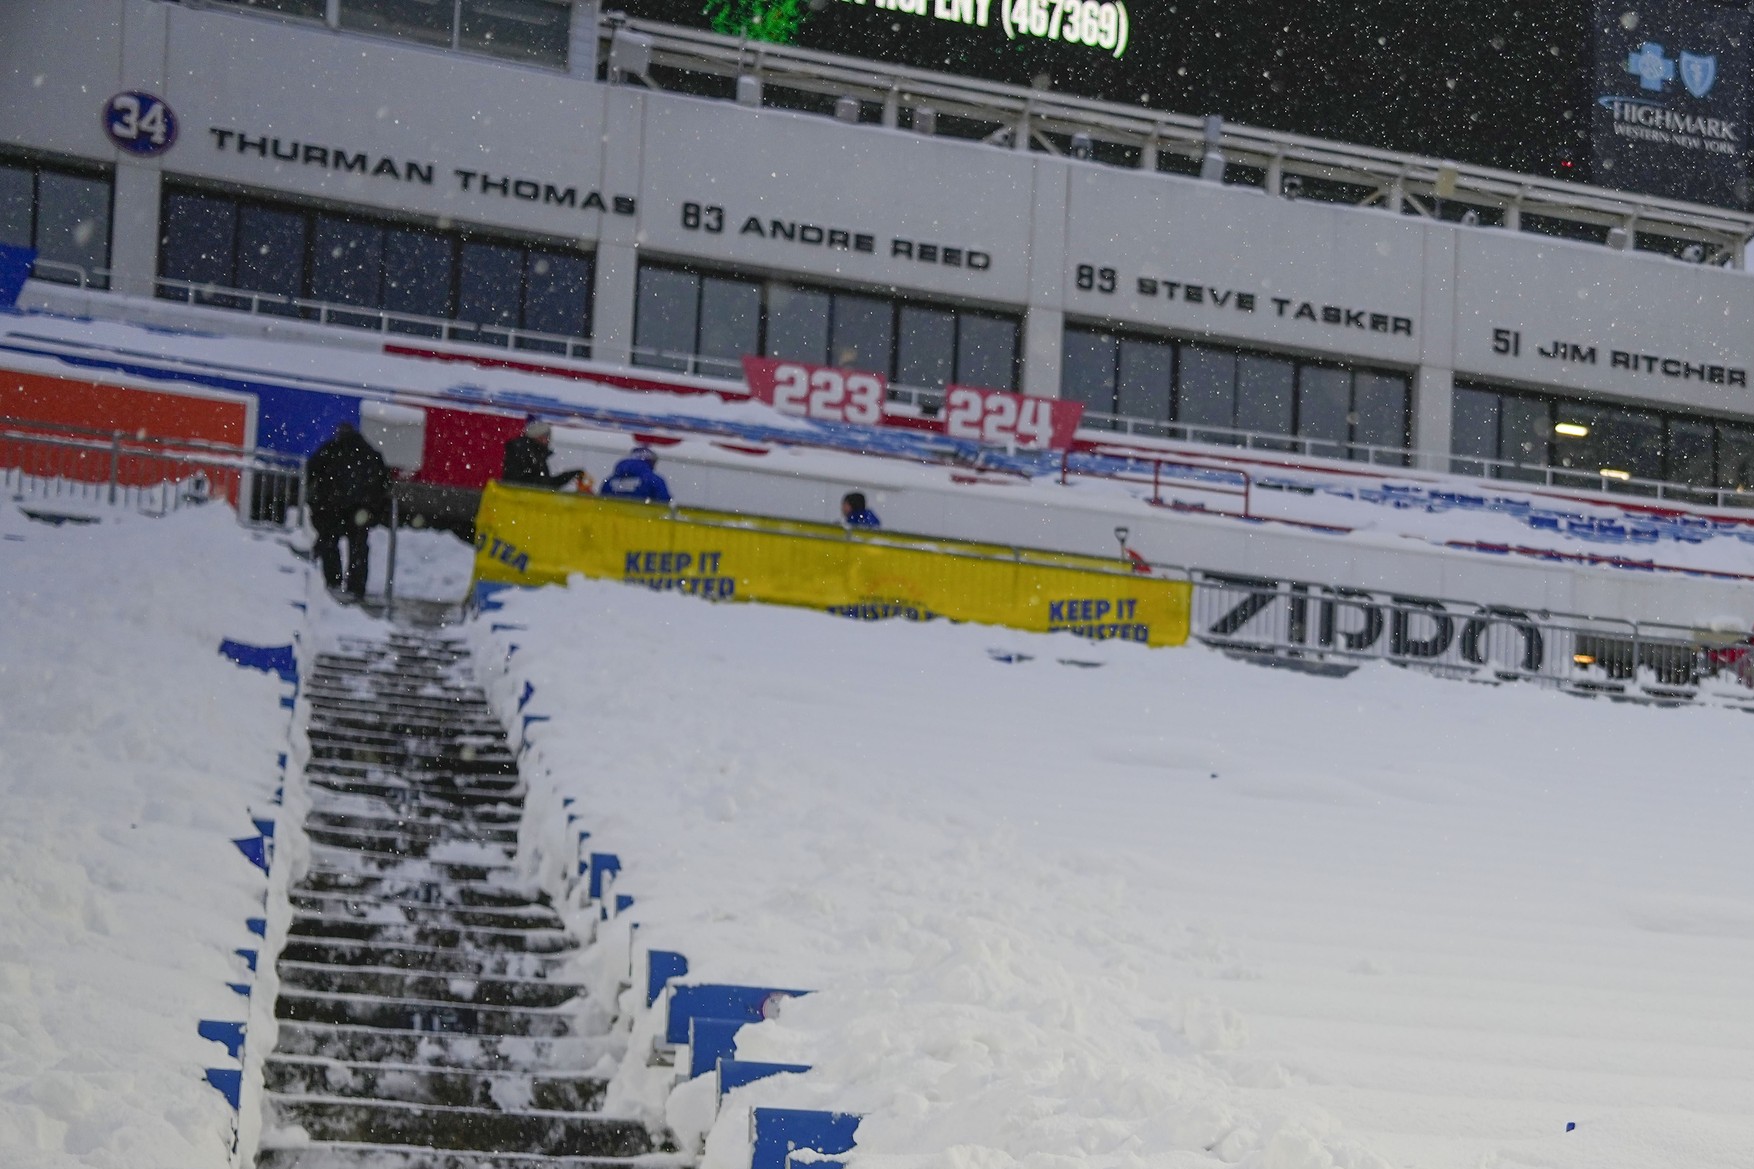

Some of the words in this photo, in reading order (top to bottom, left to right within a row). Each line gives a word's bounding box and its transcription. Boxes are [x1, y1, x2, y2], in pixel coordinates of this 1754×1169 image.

[1000, 0, 1130, 59] (467369)
[112, 94, 168, 145] 34
[1613, 100, 1740, 142] HIGHMARK
[209, 127, 434, 185] THURMAN
[455, 170, 637, 217] THOMAS
[682, 202, 724, 233] 83
[740, 215, 876, 254] ANDRE
[890, 238, 992, 271] REED
[1076, 264, 1117, 294] 89
[1136, 277, 1256, 312] STEVE
[1271, 298, 1413, 336] TASKER
[1492, 328, 1520, 357] 51
[1537, 341, 1596, 364] JIM
[1610, 350, 1747, 387] RITCHER
[773, 364, 881, 424] 223
[947, 389, 1053, 449] 224
[489, 538, 530, 573] TEA
[625, 551, 692, 574] KEEP
[699, 552, 722, 573] IT
[1049, 599, 1110, 622] KEEP
[1117, 598, 1137, 620] IT
